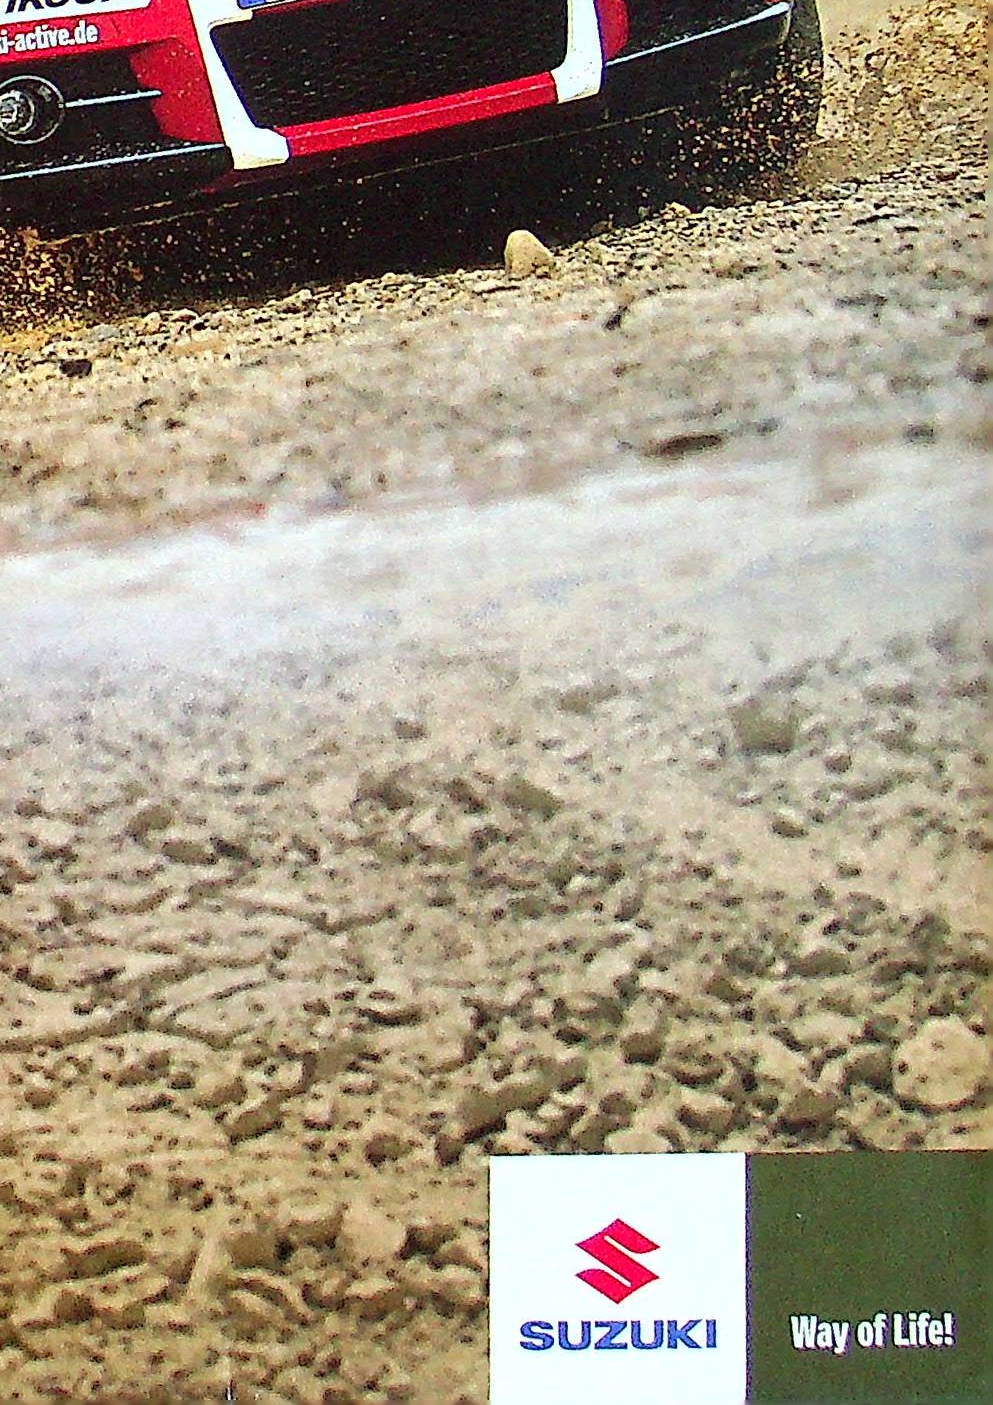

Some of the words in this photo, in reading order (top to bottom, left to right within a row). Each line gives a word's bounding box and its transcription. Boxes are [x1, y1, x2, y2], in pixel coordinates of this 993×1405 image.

[519, 1318, 717, 1351] SUZUKI
[790, 1314, 850, 1354] Way
[857, 1312, 887, 1348] of
[893, 1312, 956, 1348] Life!
